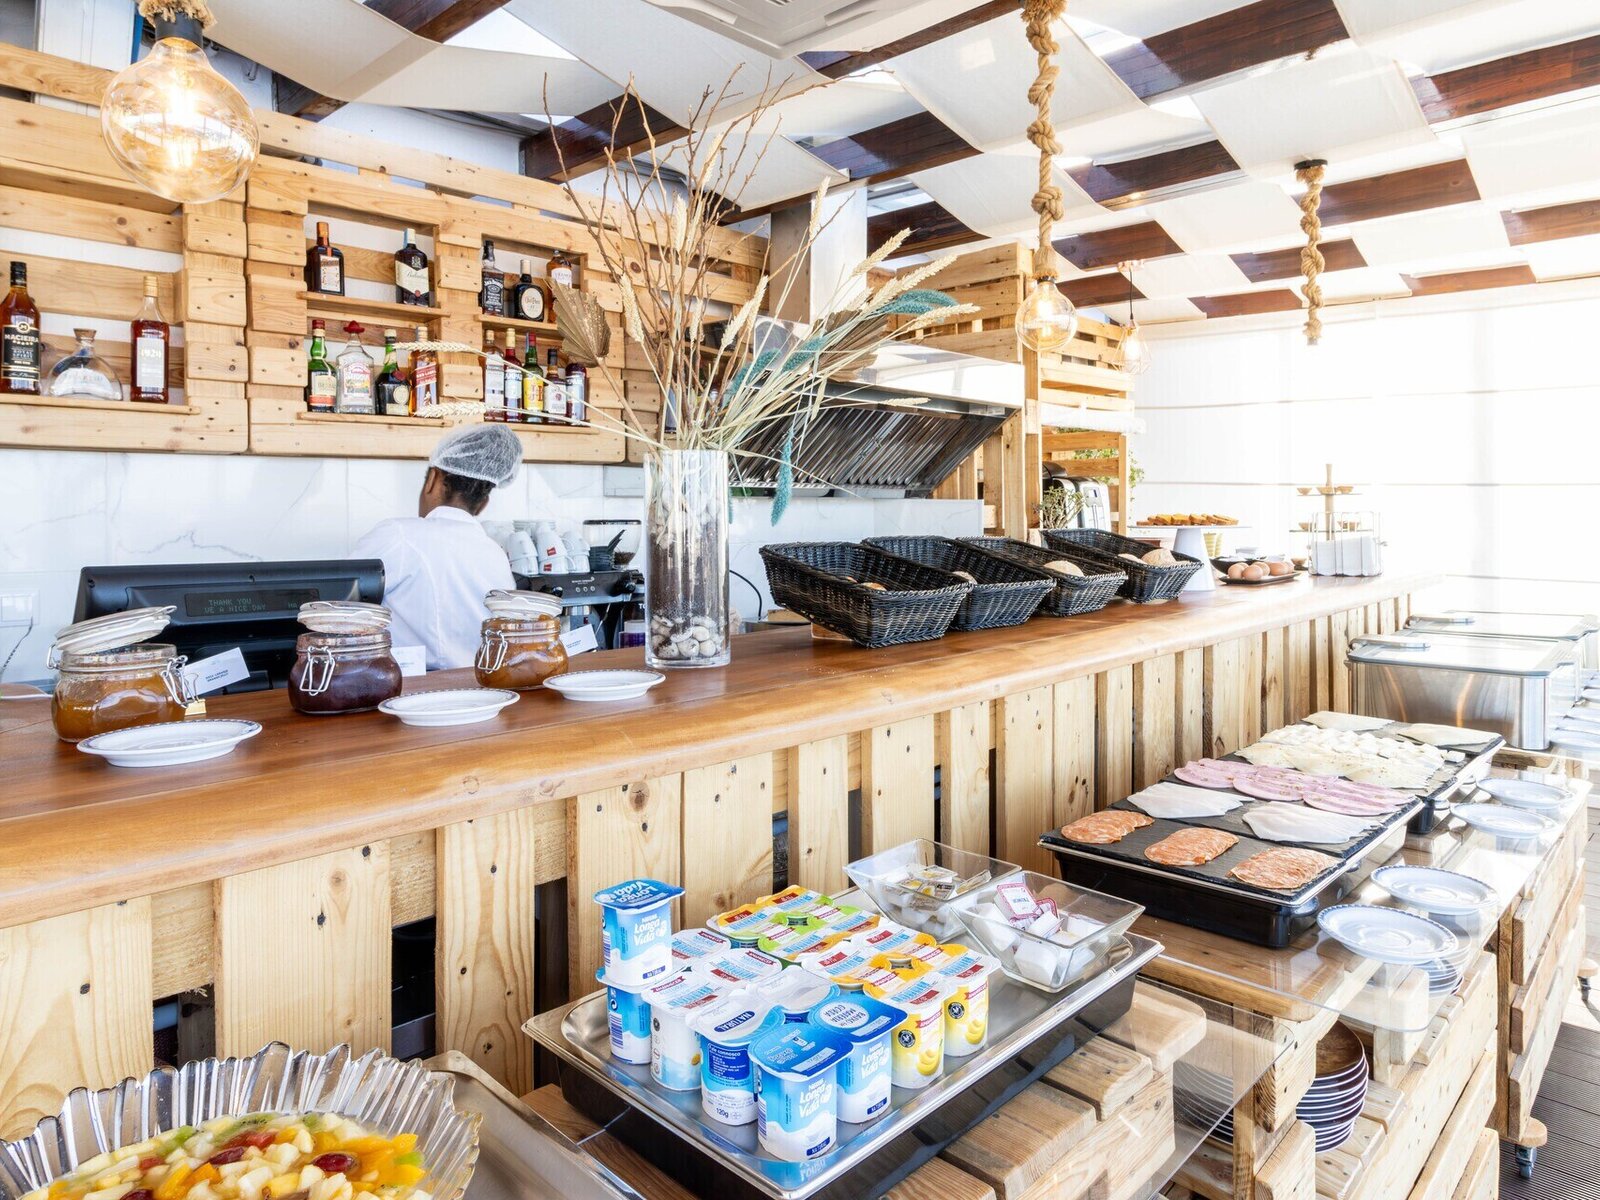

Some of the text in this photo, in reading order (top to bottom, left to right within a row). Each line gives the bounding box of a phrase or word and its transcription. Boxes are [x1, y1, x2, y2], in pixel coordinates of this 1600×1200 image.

[4, 334, 39, 343] MACIEIRA
[252, 603, 266, 611] DAY
[613, 881, 649, 895] Vida
[634, 919, 660, 934] Longa
[633, 931, 656, 946] Vida
[717, 1012, 752, 1031] NATURAL
[862, 1046, 884, 1066] Longa
[861, 1061, 879, 1080] Vida
[799, 1083, 825, 1104] Longa
[716, 1107, 729, 1119] 120g
[799, 1099, 820, 1118] Vida
